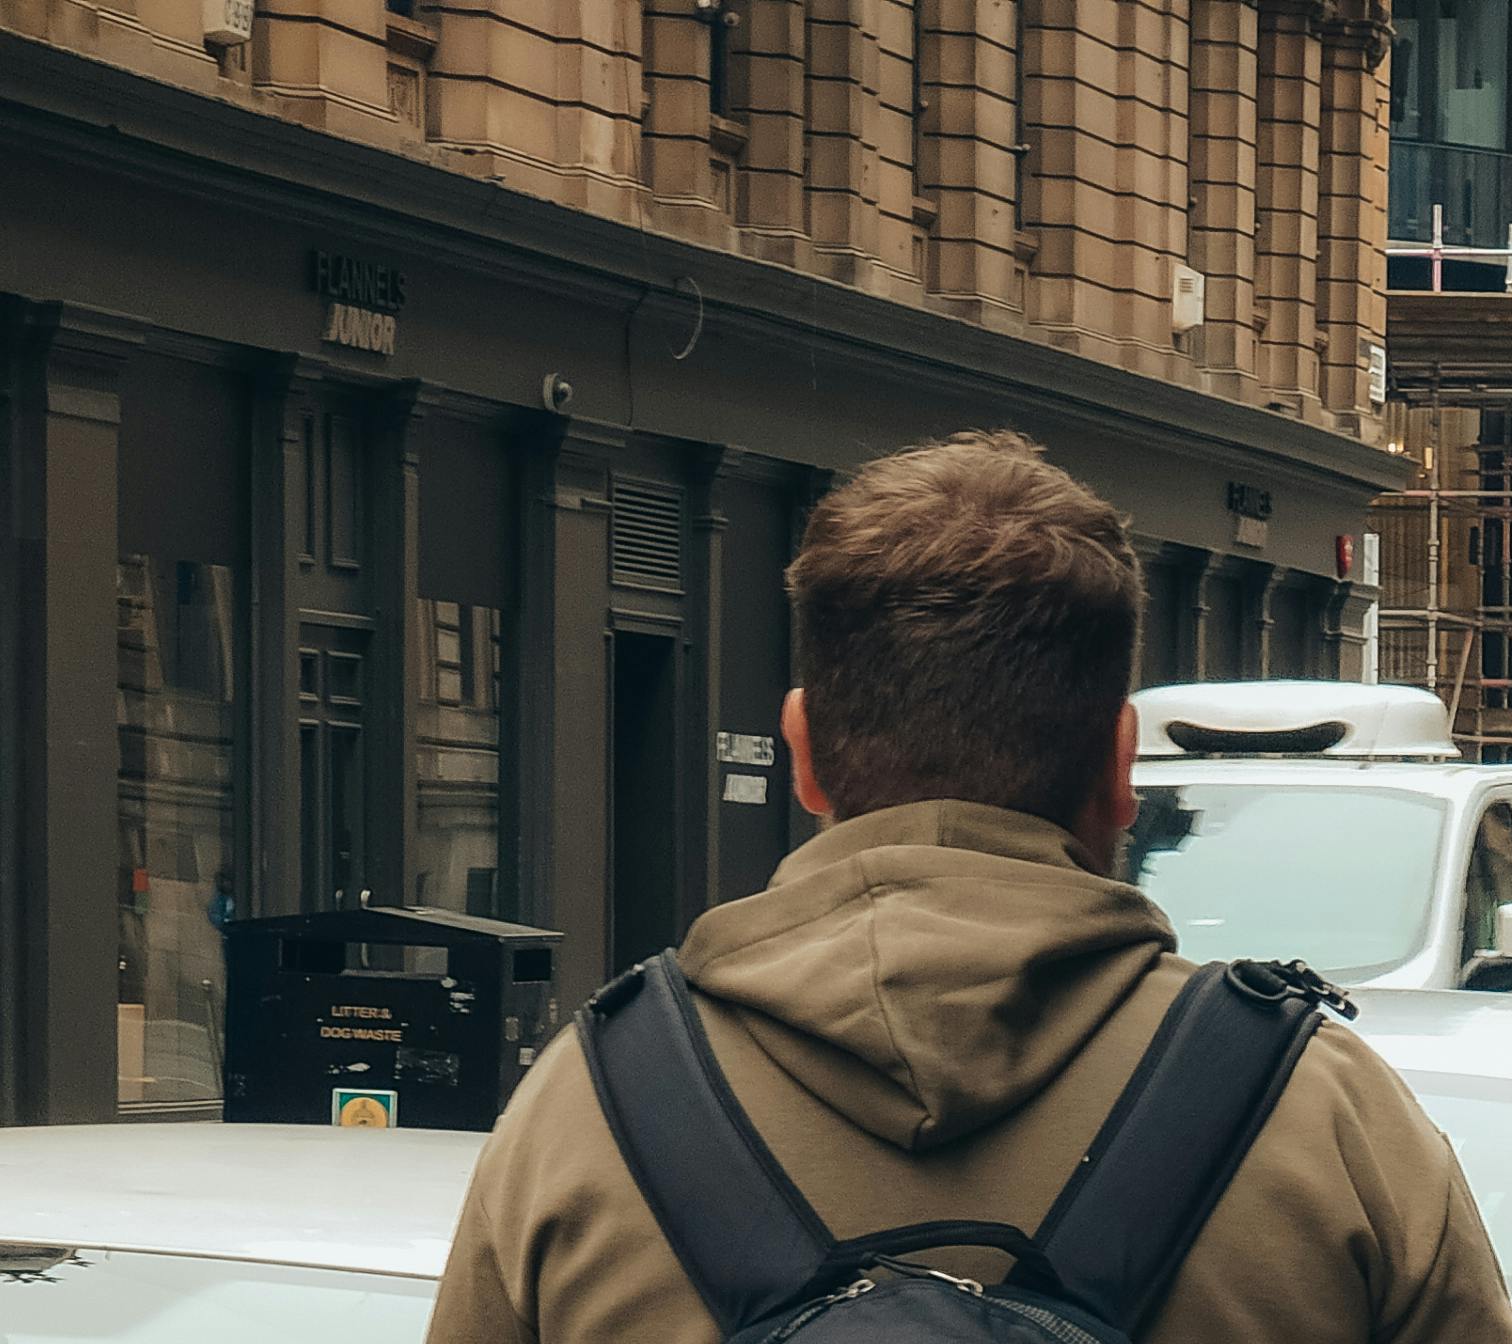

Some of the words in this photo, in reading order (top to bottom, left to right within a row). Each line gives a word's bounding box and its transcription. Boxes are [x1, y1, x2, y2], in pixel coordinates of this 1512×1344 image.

[327, 303, 396, 356] JUNIOR
[331, 1006, 378, 1019] LITTER
[320, 1026, 353, 1040] DOG
[353, 1028, 403, 1042] WASTE
